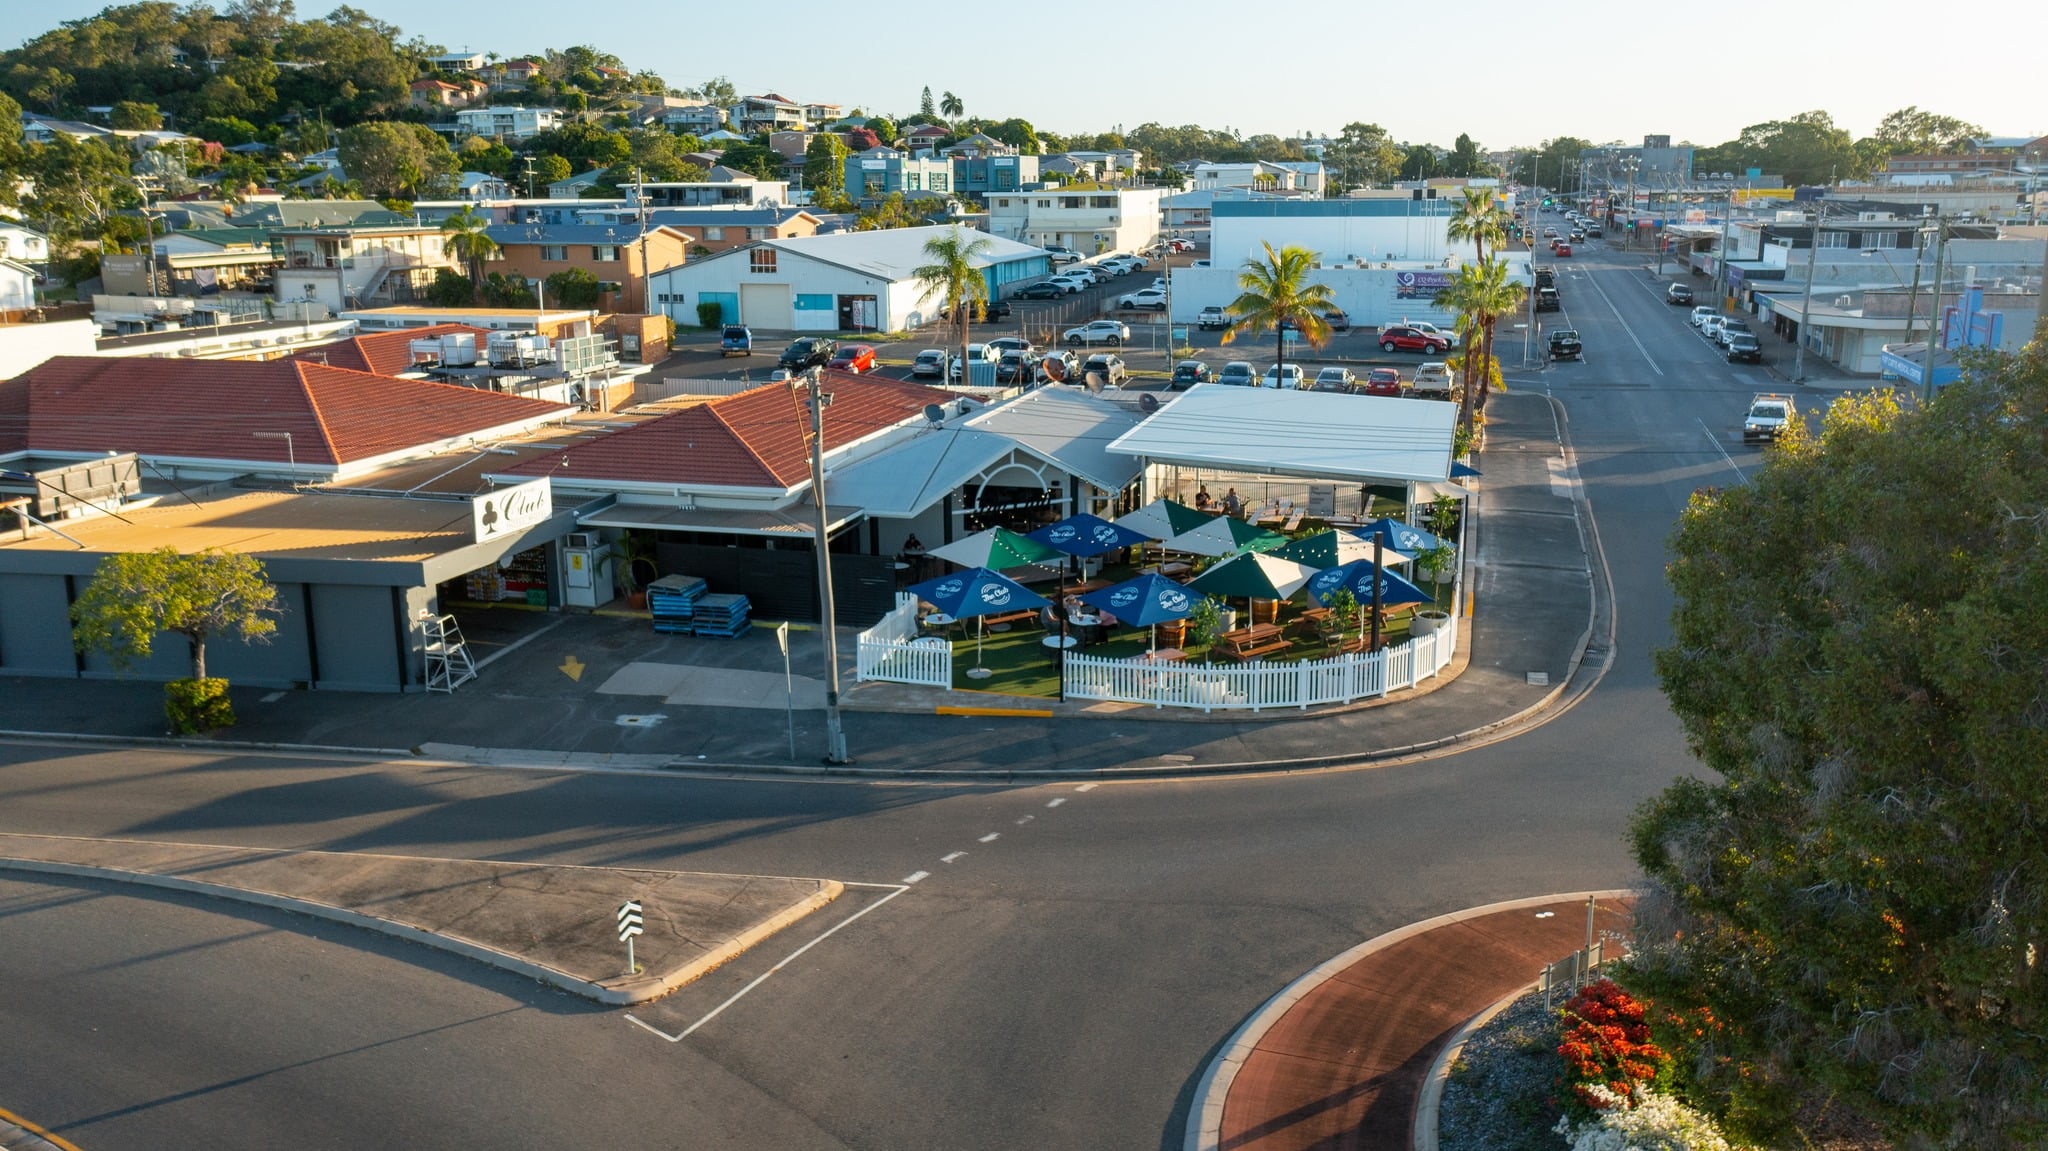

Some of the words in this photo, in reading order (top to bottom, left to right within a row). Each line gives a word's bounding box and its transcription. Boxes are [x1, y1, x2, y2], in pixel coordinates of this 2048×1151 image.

[500, 490, 545, 521] Club
[981, 593, 995, 602] The
[994, 586, 1009, 597] Club
[1358, 584, 1371, 593] The
[1160, 600, 1173, 609] The
[1171, 592, 1186, 603] Club
